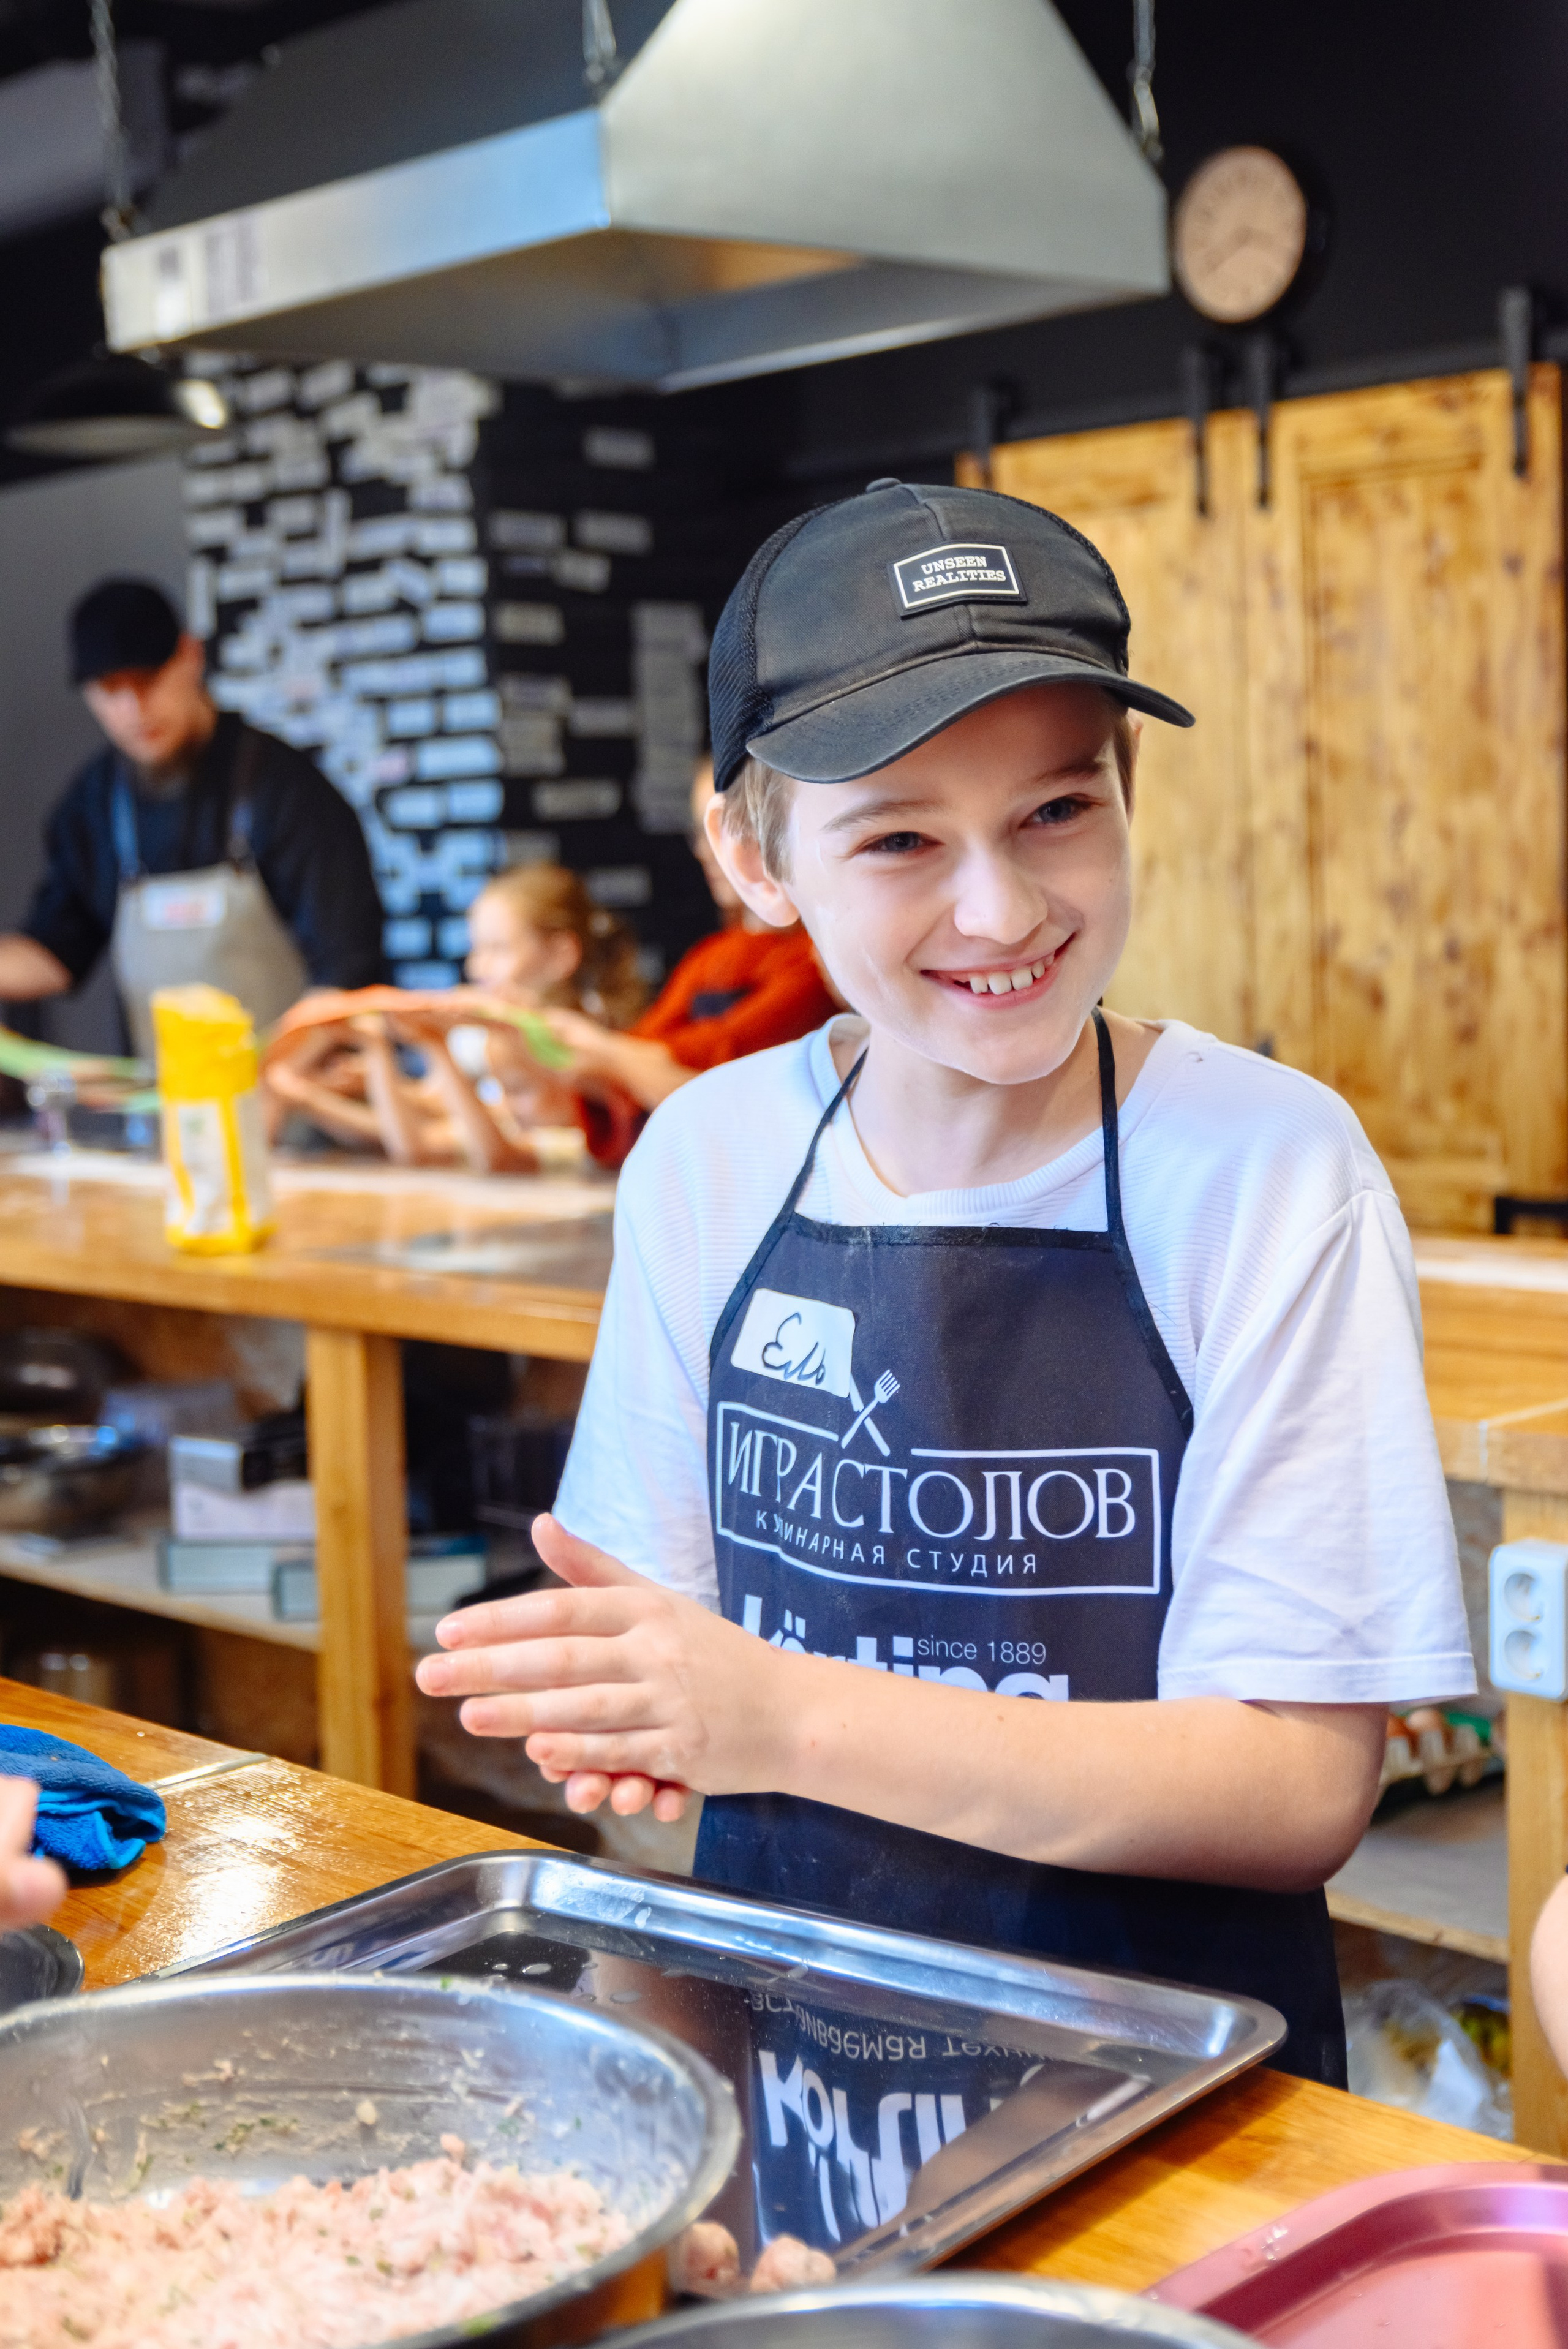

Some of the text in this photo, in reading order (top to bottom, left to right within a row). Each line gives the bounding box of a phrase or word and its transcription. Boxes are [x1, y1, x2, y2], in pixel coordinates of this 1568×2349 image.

[912, 569, 1007, 592] REALITIES
[921, 556, 987, 575] UNSEEN
[728, 1421, 1136, 1541] ИГРАСТОЛОВ
[907, 1548, 1037, 1578] СТУДИЯ
[917, 1634, 1047, 1665] since 1889
